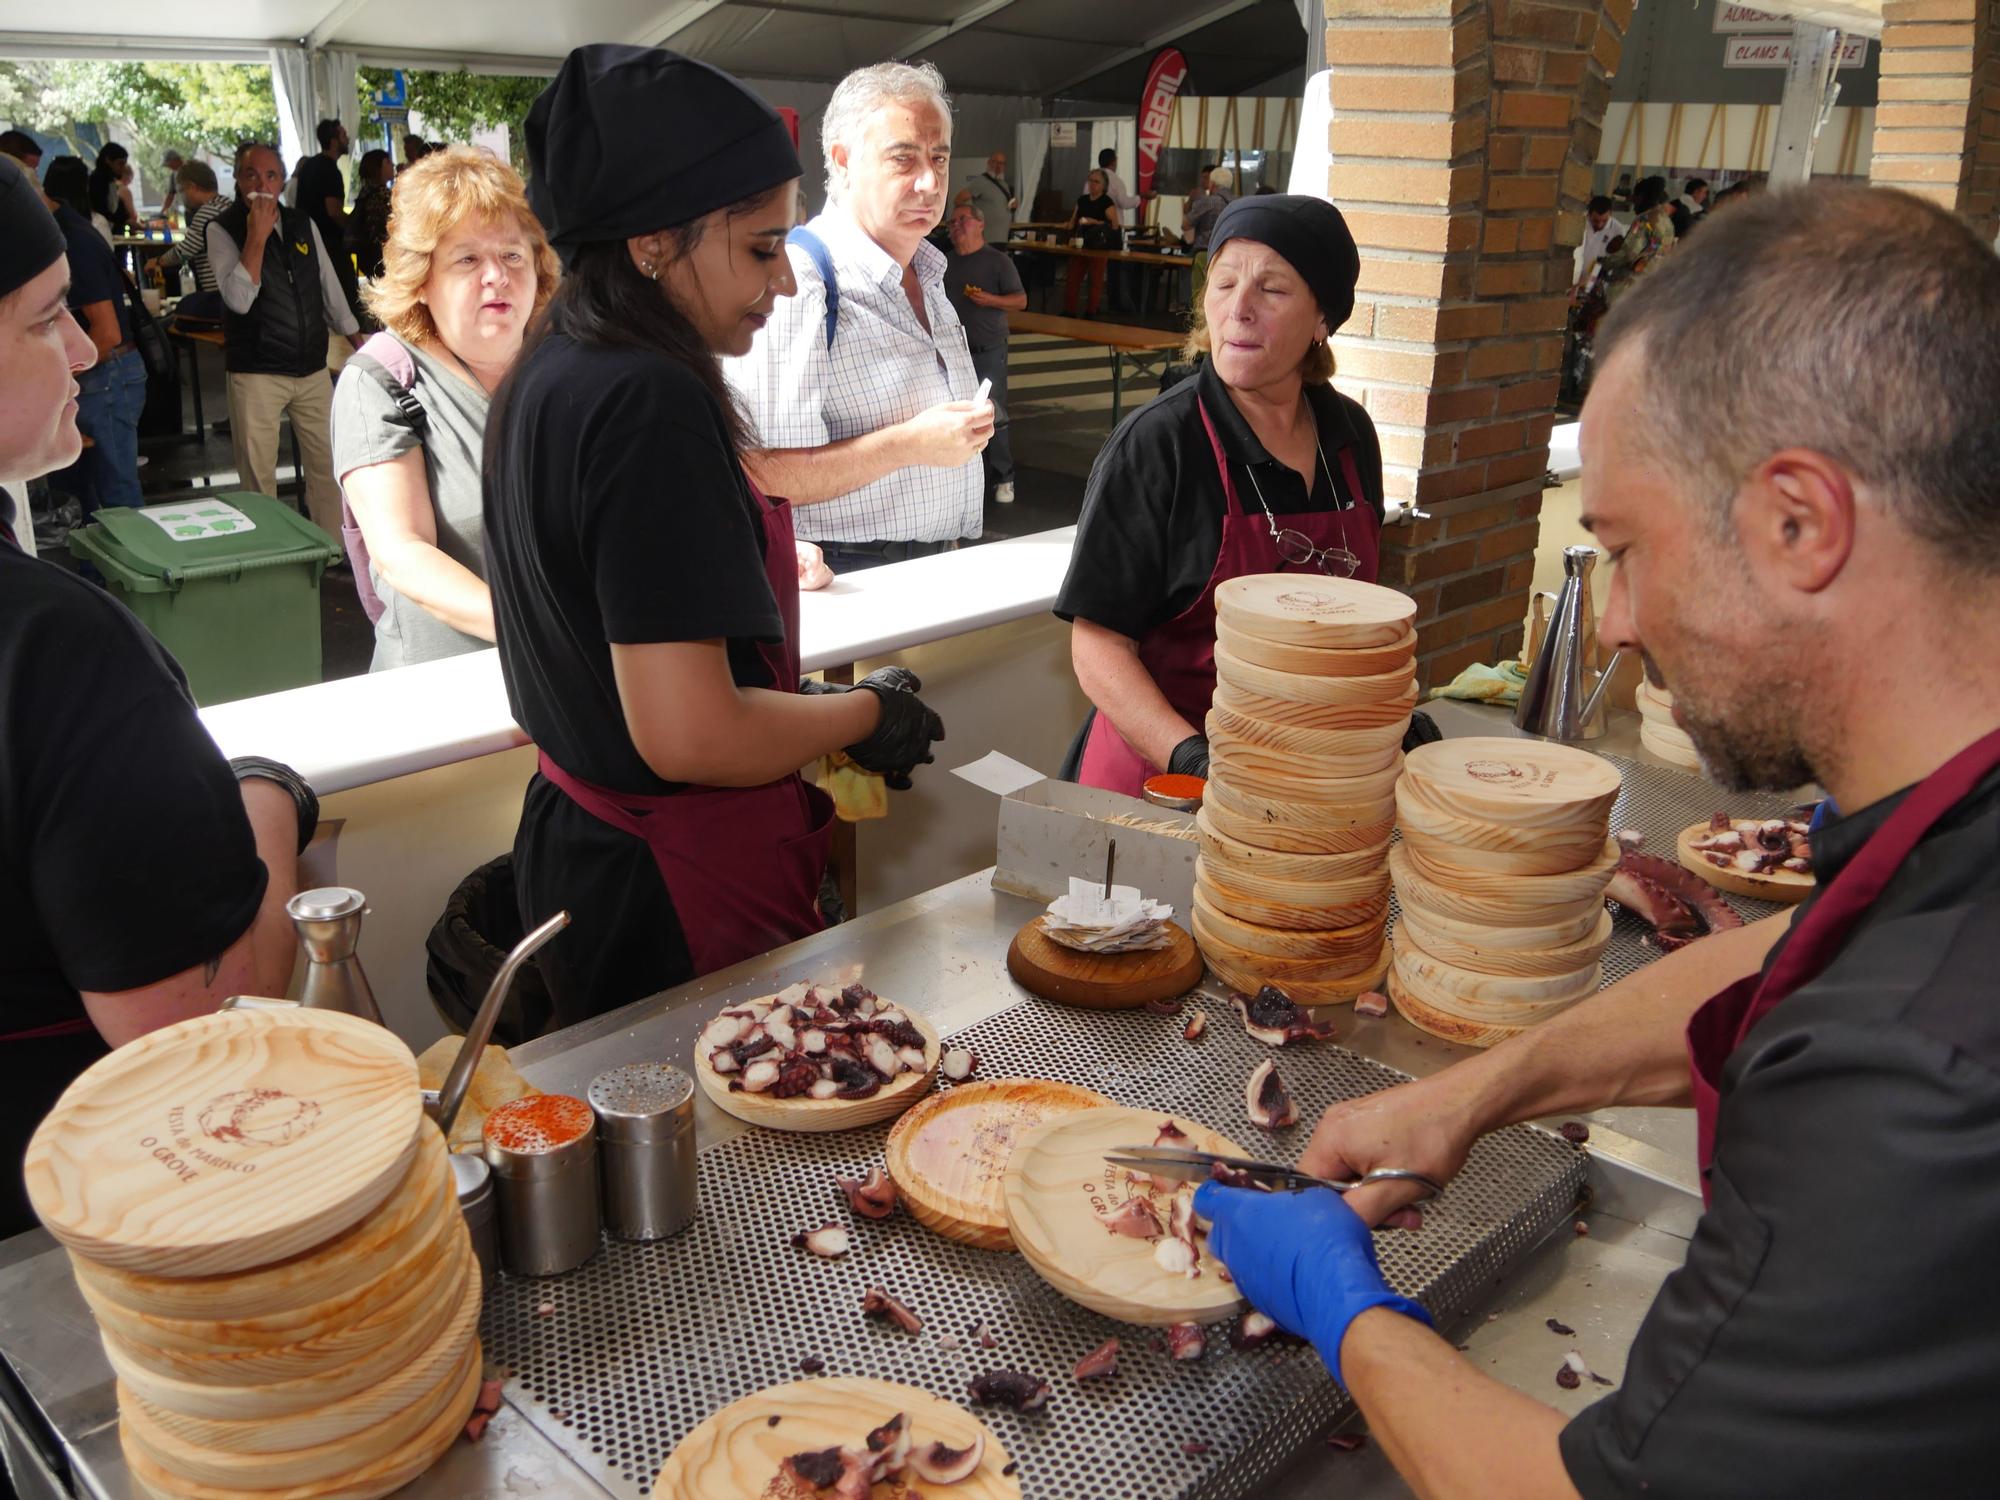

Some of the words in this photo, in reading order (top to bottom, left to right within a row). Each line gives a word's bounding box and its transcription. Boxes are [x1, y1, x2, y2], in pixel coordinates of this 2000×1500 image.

[1735, 46, 1777, 60] CLAMS
[1138, 69, 1187, 163] ABRIL
[169, 1106, 184, 1136] FESTA
[176, 1138, 192, 1149] do
[141, 1137, 157, 1147] O
[153, 1147, 199, 1182] GROVE
[189, 1148, 256, 1173] MARISCO
[1104, 1163, 1118, 1191] FESTA
[1082, 1183, 1096, 1193] O
[1089, 1195, 1118, 1237] GRE
[1107, 1193, 1120, 1207] do
